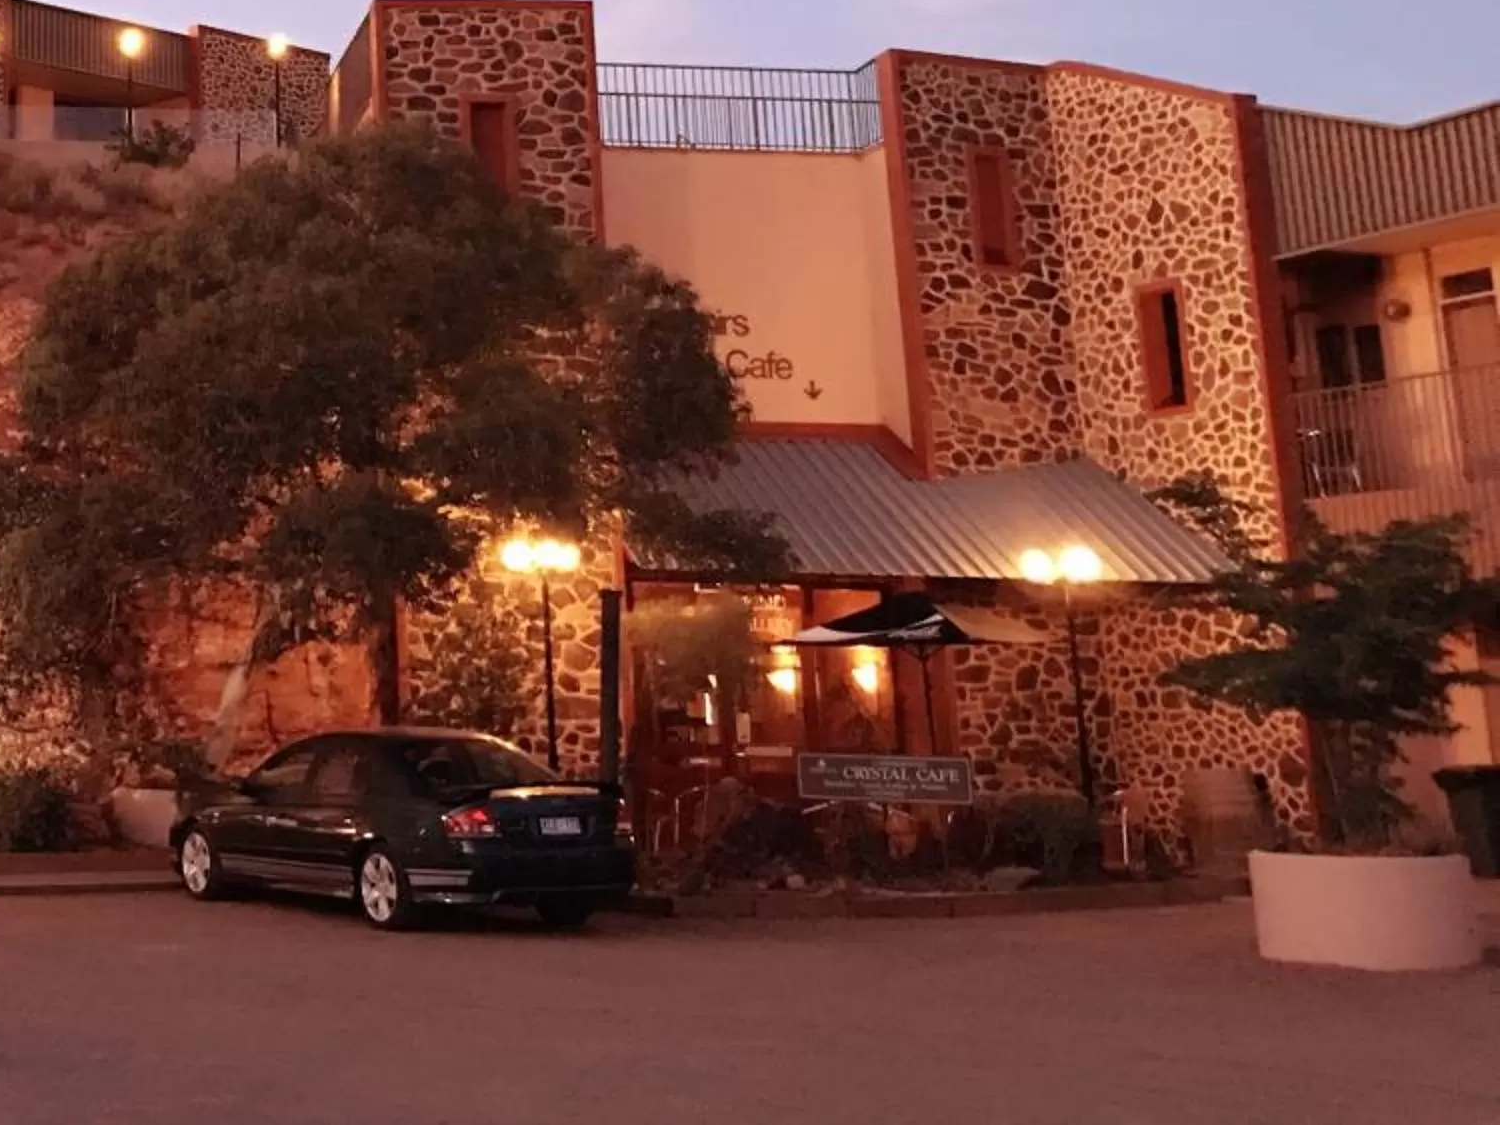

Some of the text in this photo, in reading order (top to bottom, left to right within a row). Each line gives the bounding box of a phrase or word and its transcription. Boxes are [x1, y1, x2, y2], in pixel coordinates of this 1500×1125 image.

[725, 349, 793, 380] Cafe
[843, 765, 911, 781] CRYSTAL
[915, 768, 961, 784] CAFE
